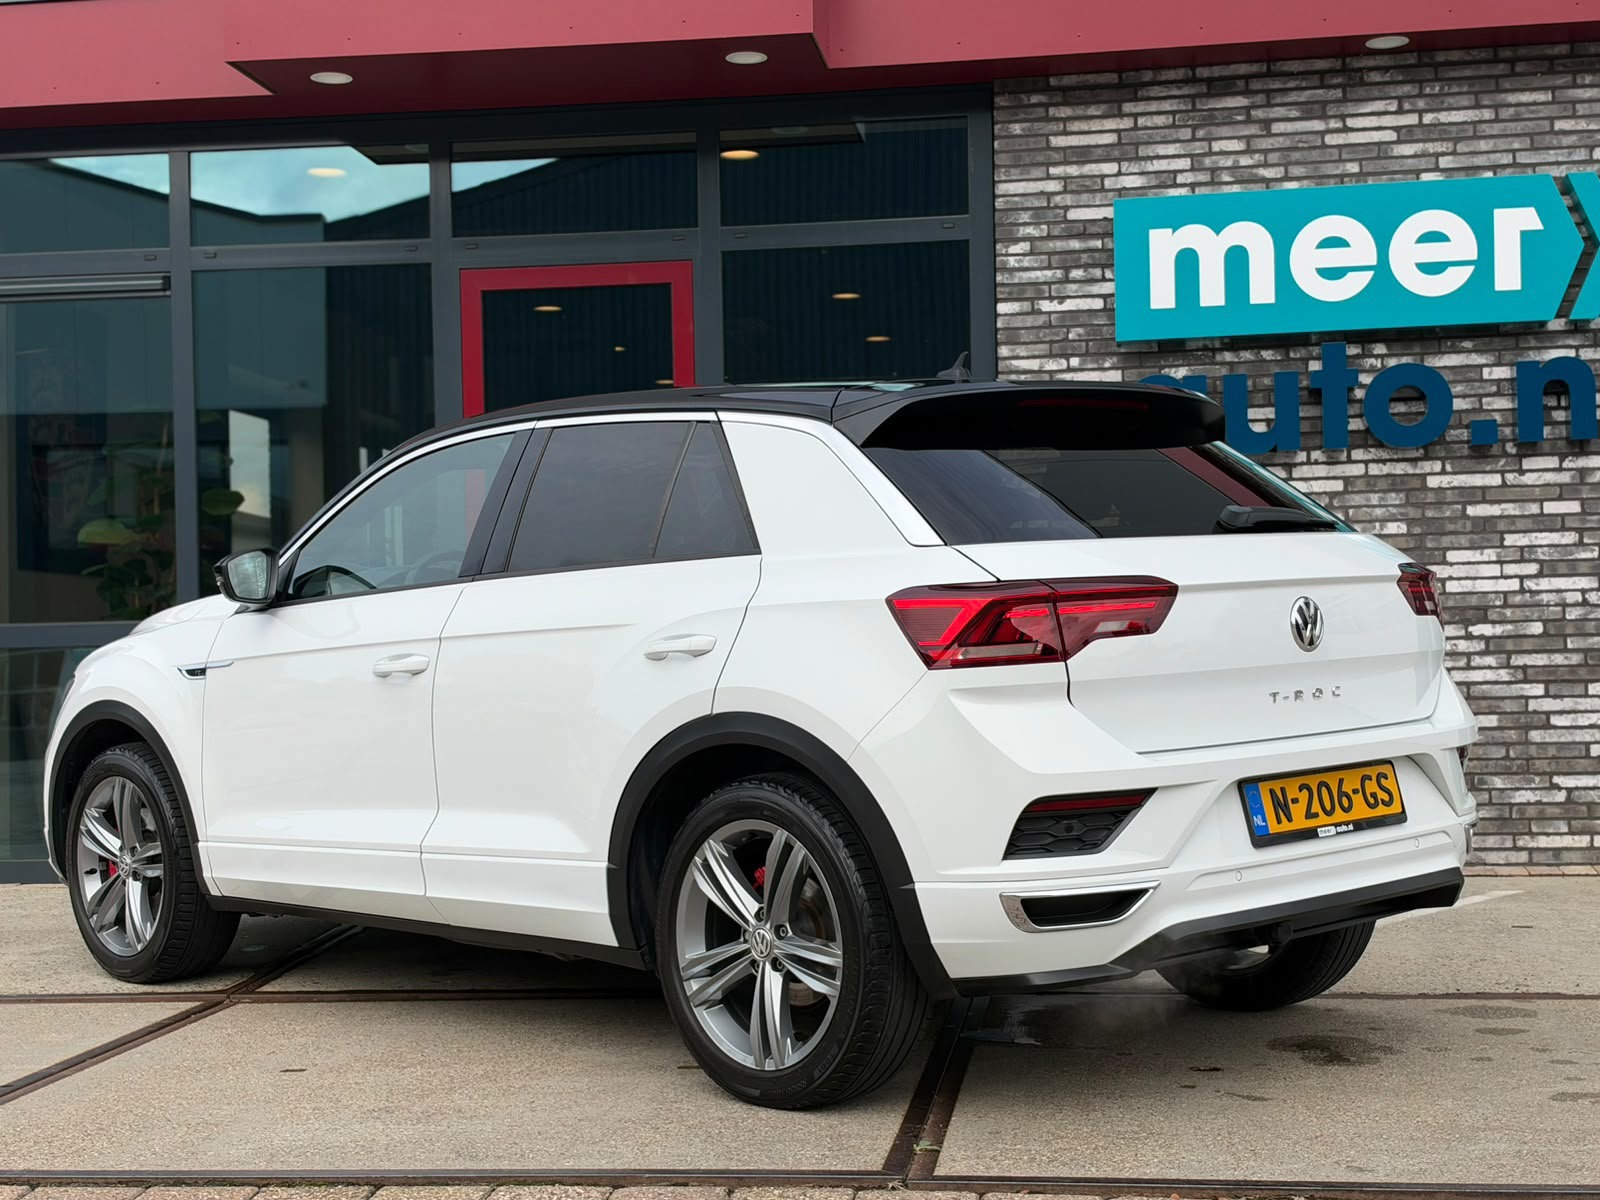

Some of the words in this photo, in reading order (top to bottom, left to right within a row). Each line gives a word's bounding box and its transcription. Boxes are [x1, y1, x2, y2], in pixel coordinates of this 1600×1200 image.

[1149, 206, 1544, 309] meer
[1137, 341, 1598, 454] uto.n
[1268, 685, 1341, 704] T-ROC
[1253, 814, 1266, 827] NL
[1268, 771, 1395, 825] N-206-GS
